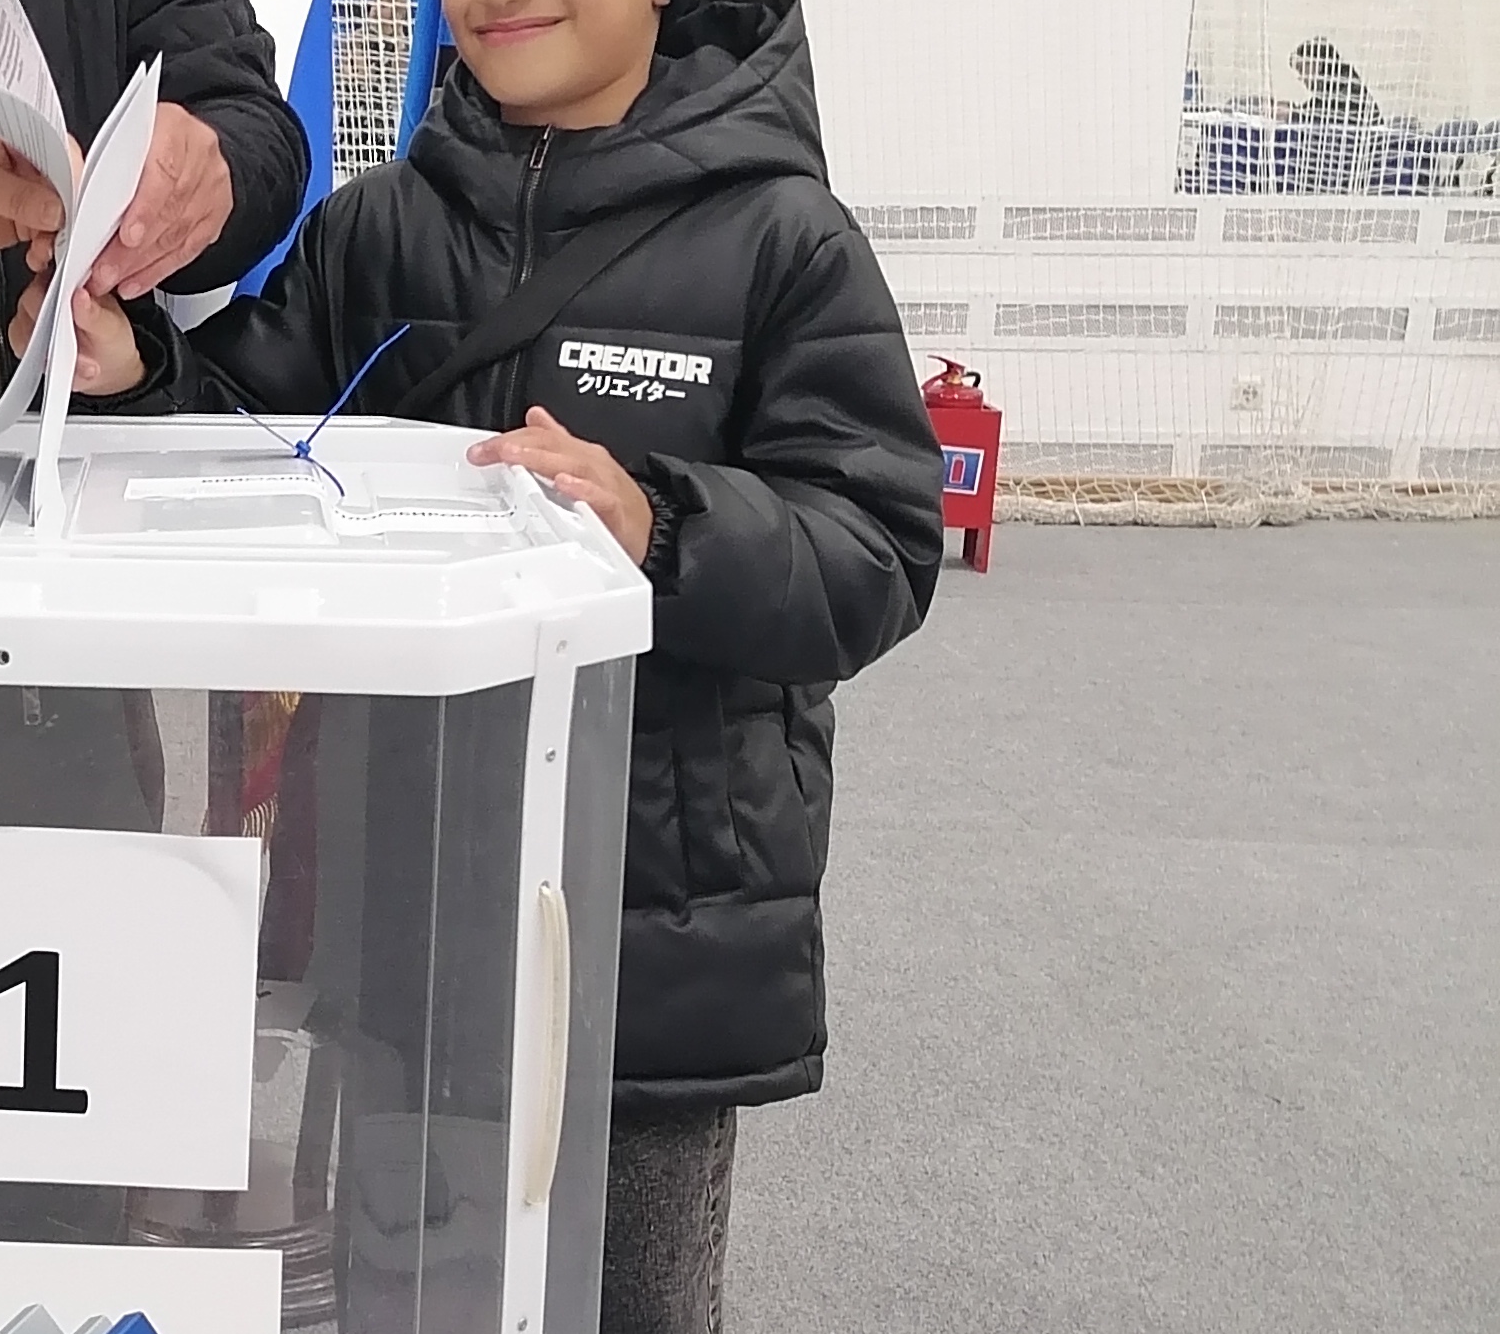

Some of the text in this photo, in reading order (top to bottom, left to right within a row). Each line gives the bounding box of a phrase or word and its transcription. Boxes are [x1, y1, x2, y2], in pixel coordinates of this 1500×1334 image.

[559, 341, 713, 384] CREATOR
[577, 374, 687, 402] クリエイター
